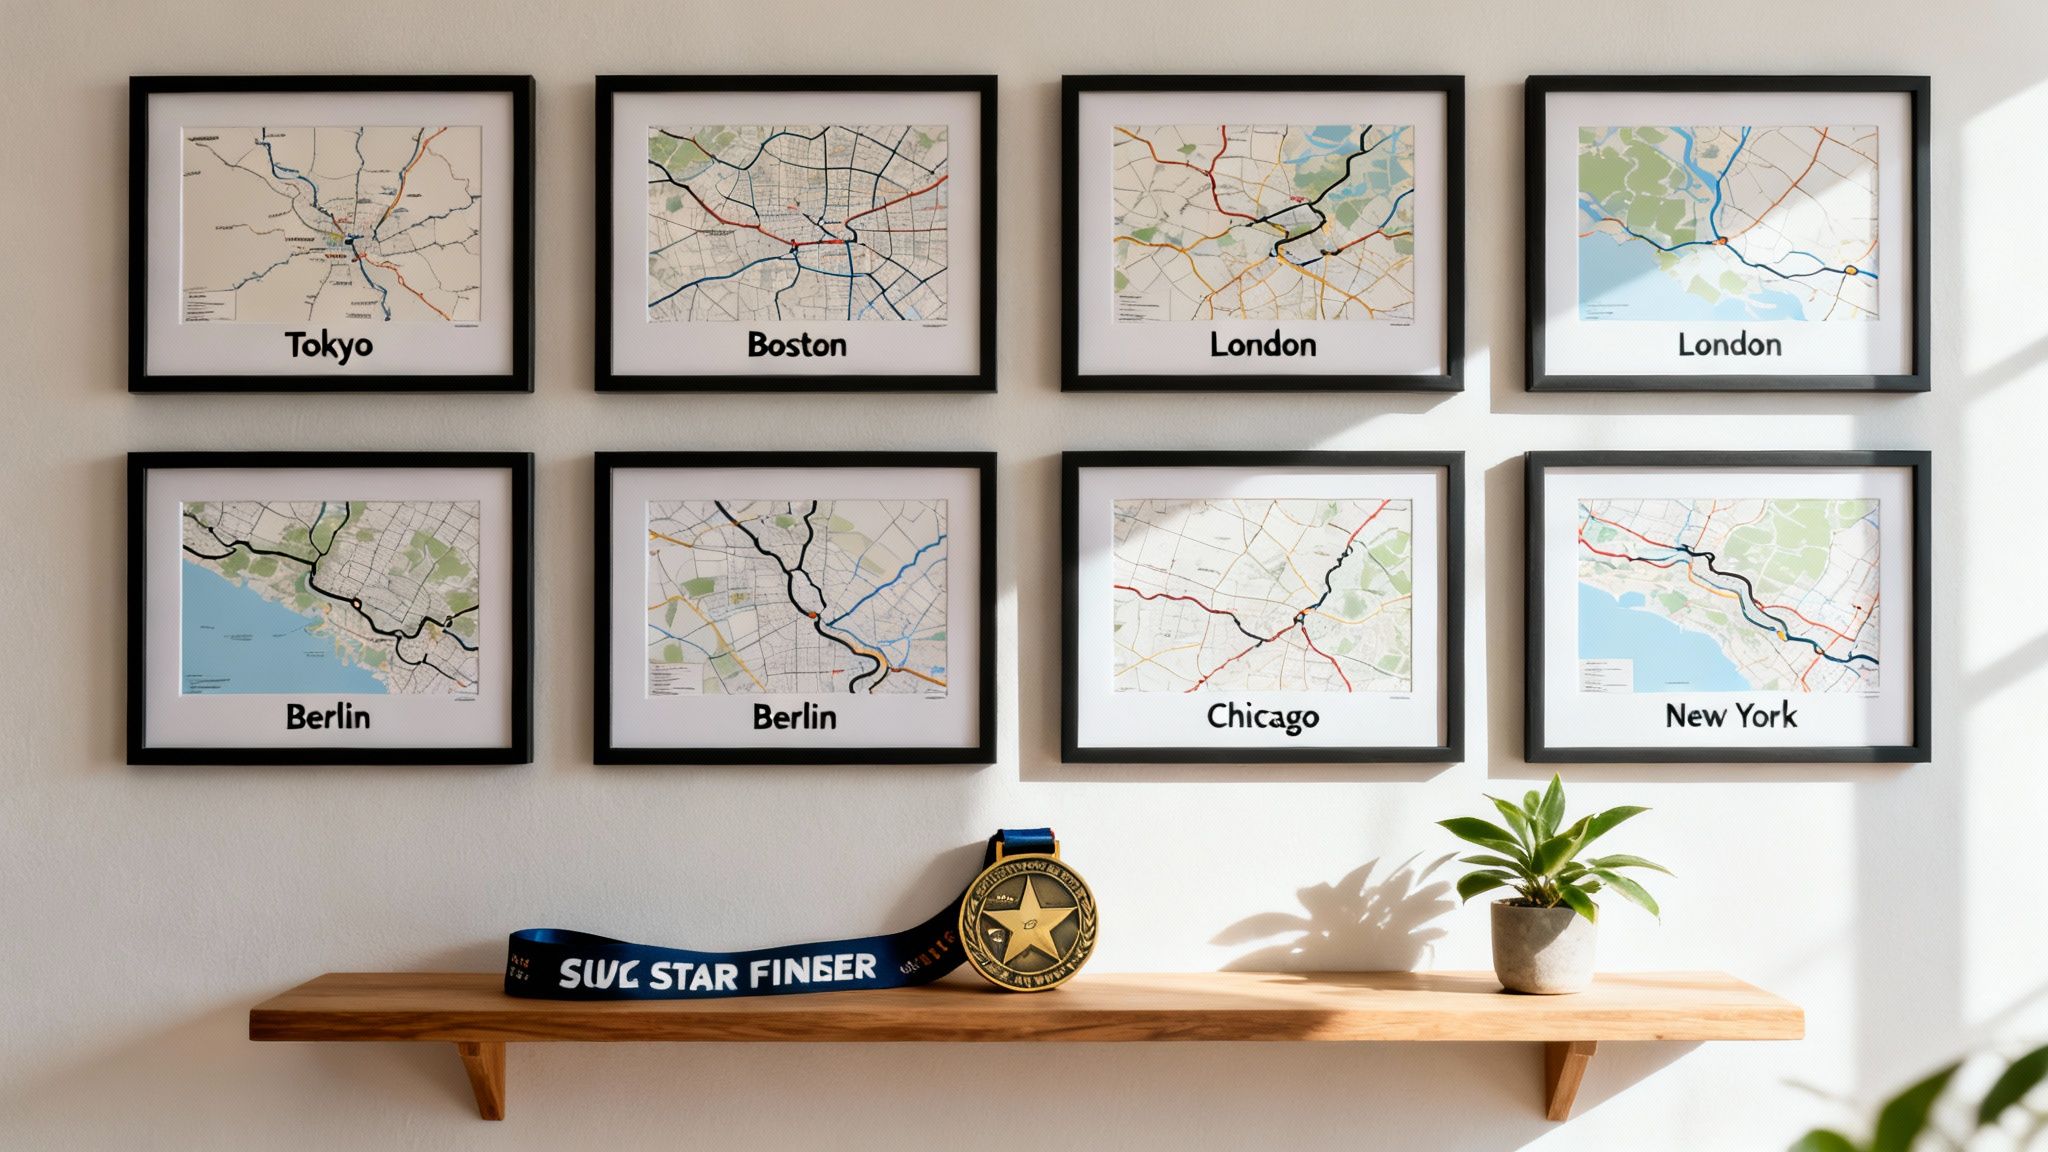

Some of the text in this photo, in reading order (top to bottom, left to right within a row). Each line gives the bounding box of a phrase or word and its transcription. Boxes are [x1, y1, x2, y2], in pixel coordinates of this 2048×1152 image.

[285, 329, 374, 366] Tokyo
[748, 331, 847, 358] Boston
[1211, 329, 1317, 357] London
[1679, 330, 1782, 356] London
[287, 702, 371, 730] Berlin
[754, 702, 837, 730] Berlin
[1207, 702, 1320, 737] Chicago
[1666, 700, 1798, 728] New York
[650, 961, 738, 991] STAR
